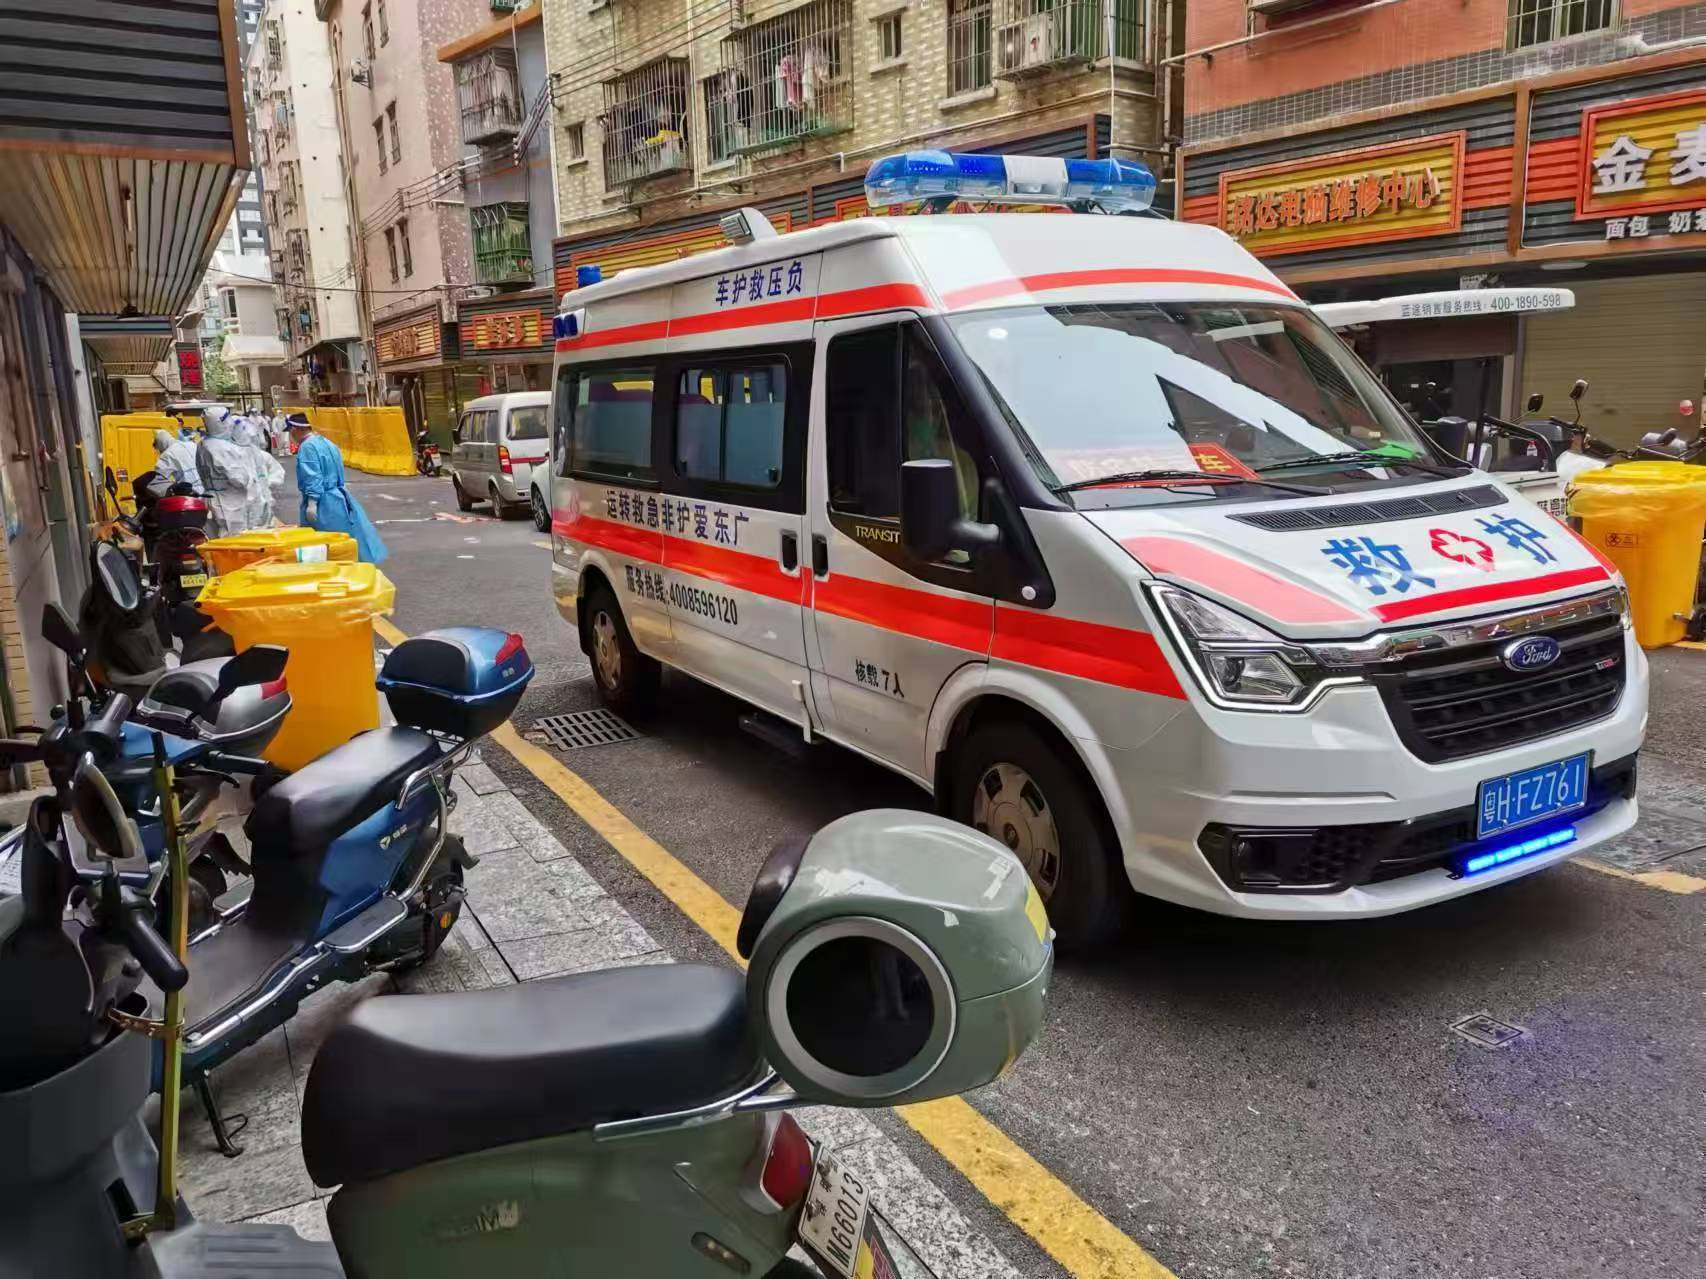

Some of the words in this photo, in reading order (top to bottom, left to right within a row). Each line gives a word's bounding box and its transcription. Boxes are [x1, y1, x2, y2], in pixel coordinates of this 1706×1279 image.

[1605, 215, 1649, 240] 面包
[855, 525, 900, 544] TRANSIT
[1522, 643, 1552, 665] Ford
